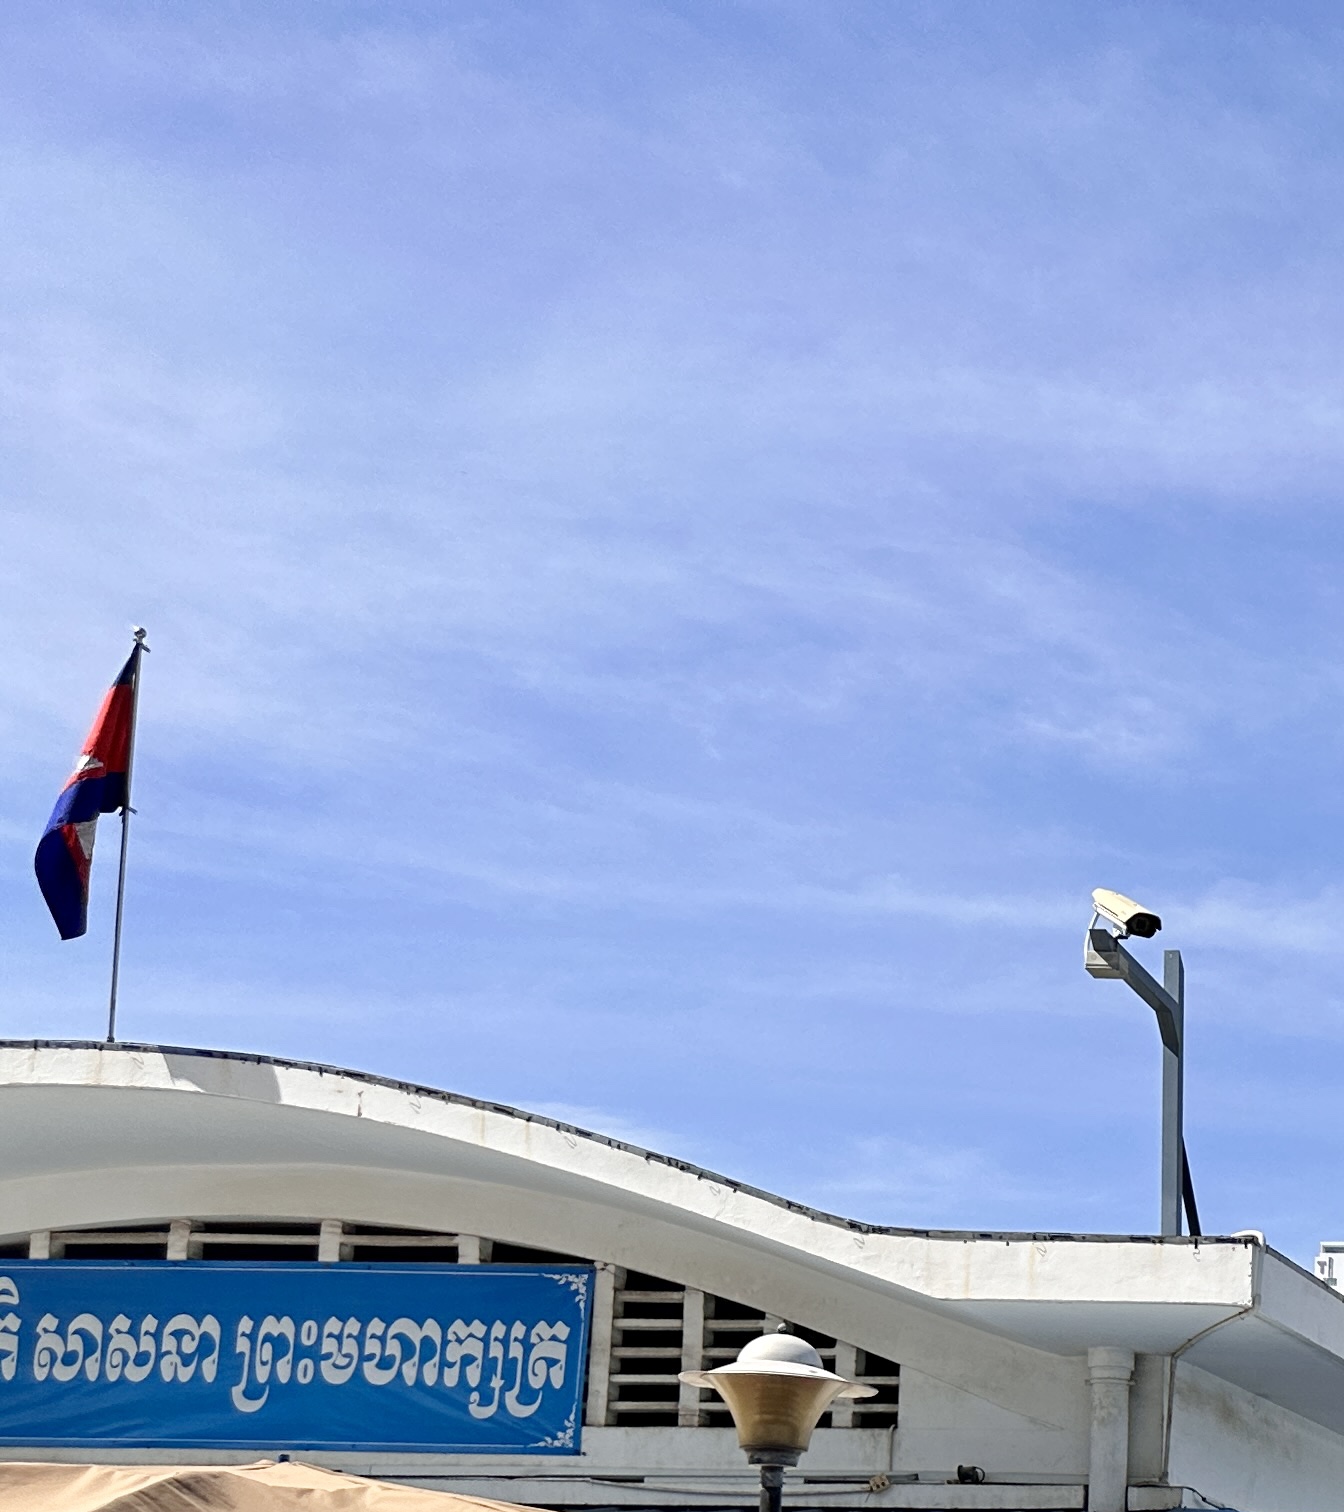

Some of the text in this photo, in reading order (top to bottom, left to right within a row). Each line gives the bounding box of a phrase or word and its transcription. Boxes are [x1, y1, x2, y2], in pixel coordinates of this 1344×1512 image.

[33, 1312, 222, 1383] សាសនា
[230, 1313, 571, 1420] ព្រះមហាក្សត្រ
